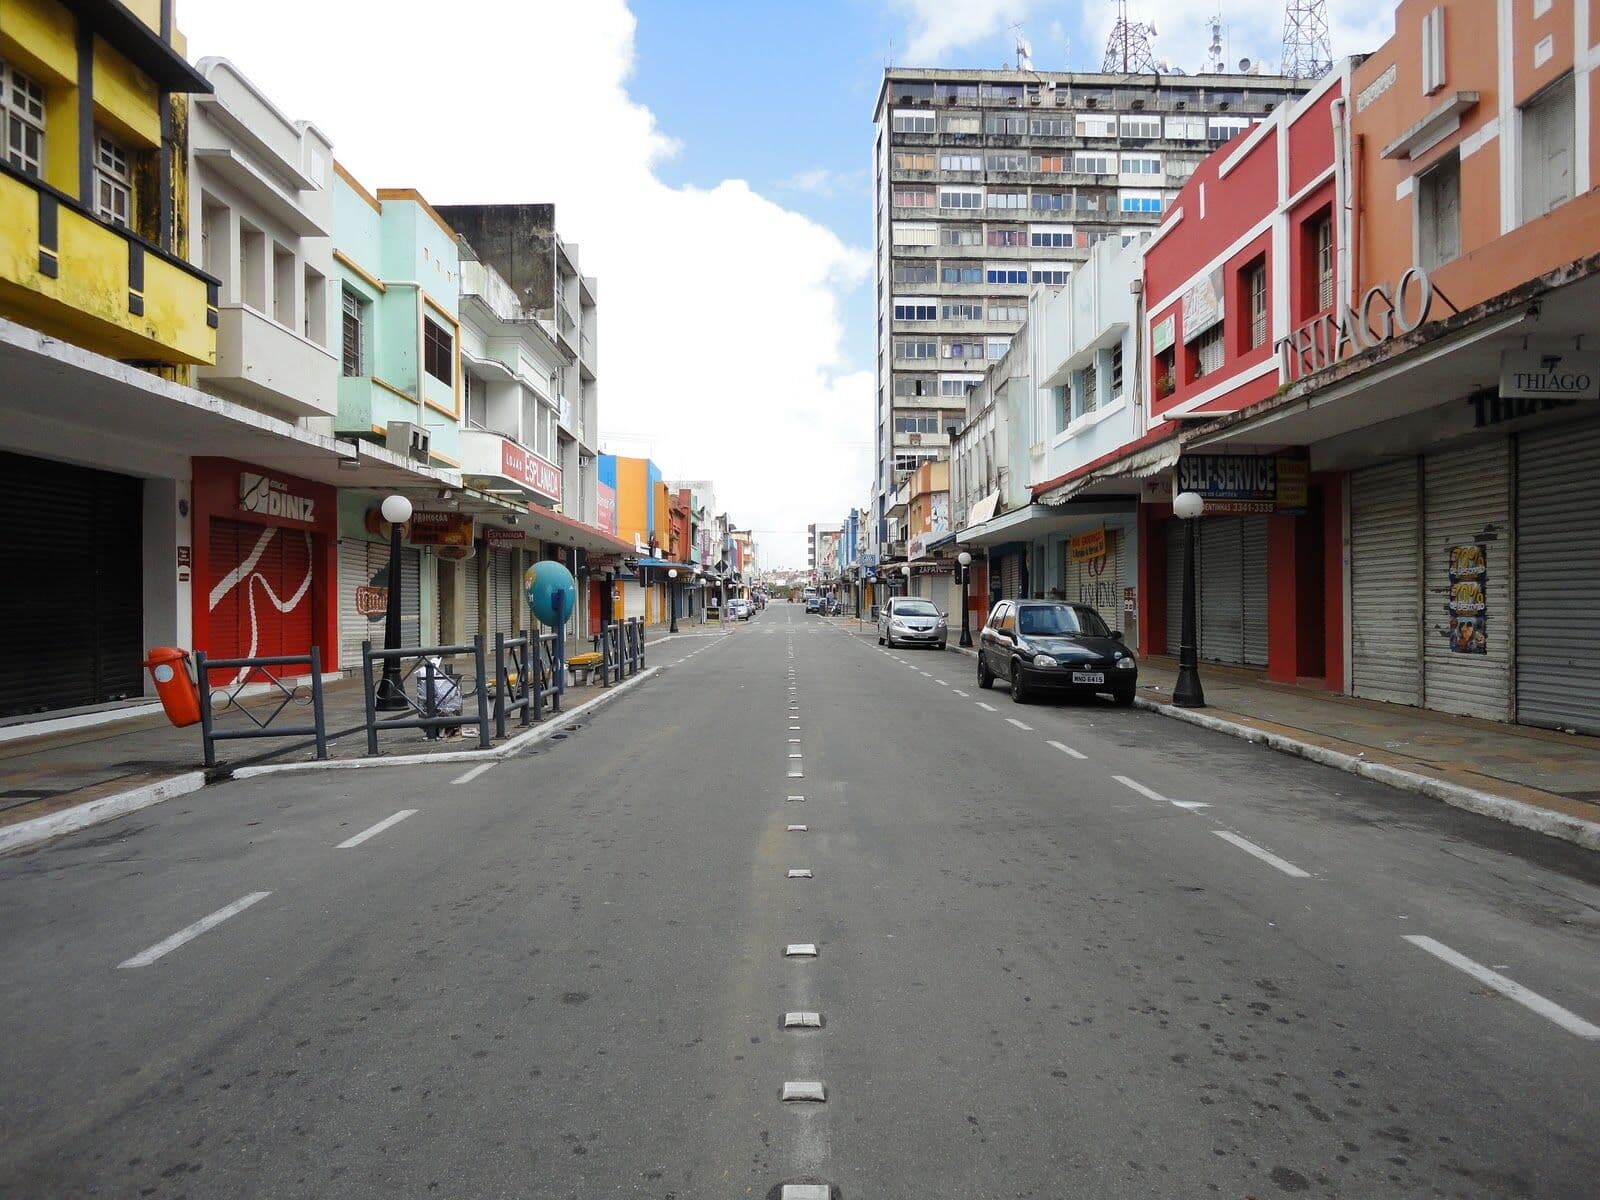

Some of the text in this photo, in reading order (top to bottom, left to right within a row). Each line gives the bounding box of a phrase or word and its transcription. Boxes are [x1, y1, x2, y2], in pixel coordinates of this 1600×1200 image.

[1274, 266, 1432, 386] THIAGO
[1514, 373, 1591, 391] THIAGO
[525, 454, 560, 498] ESPLANADA
[1180, 456, 1275, 491] SELF-SERVICE
[269, 490, 315, 523] DINIZ
